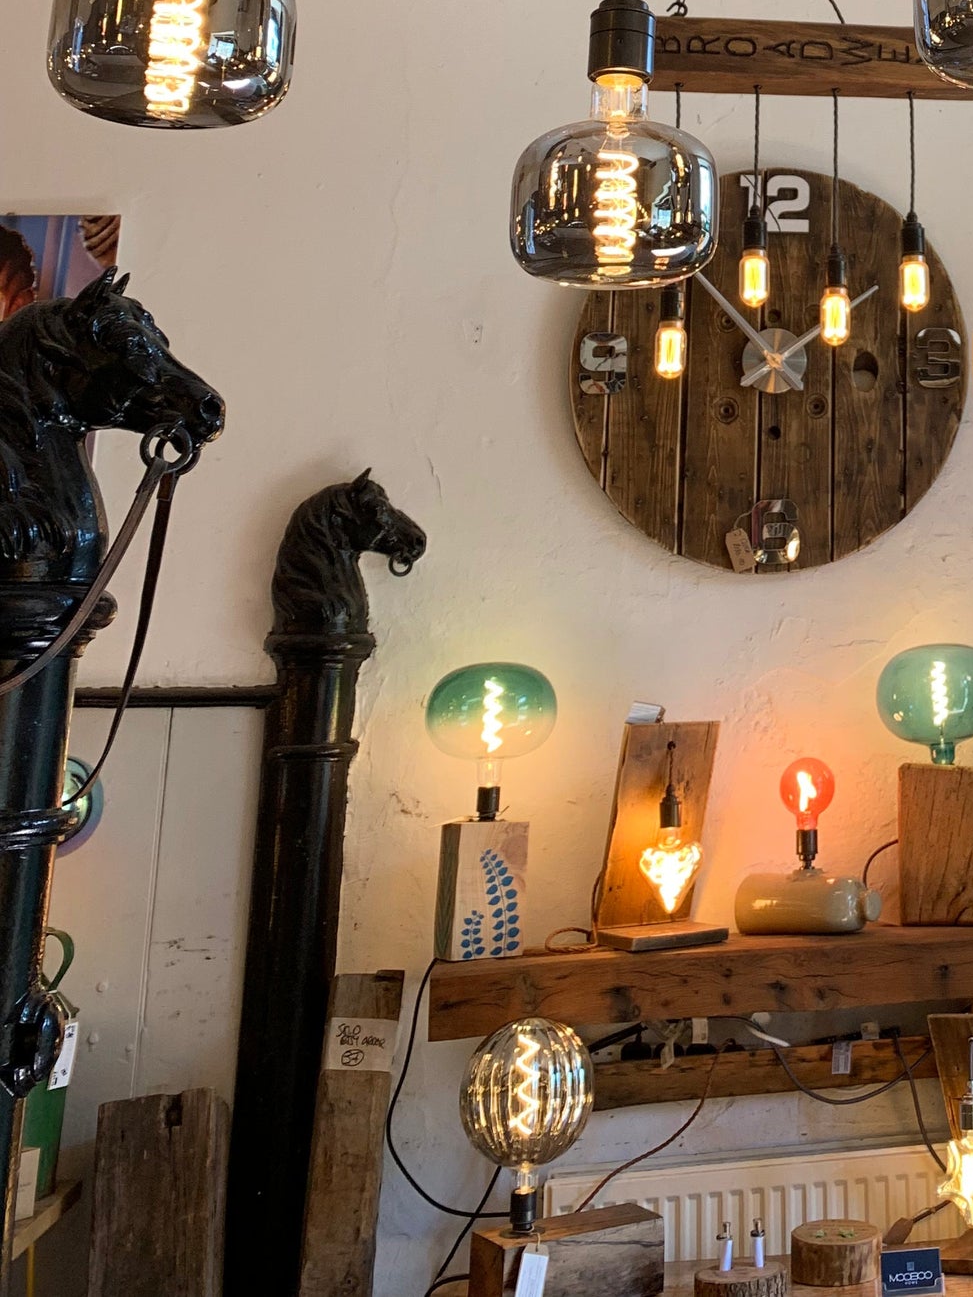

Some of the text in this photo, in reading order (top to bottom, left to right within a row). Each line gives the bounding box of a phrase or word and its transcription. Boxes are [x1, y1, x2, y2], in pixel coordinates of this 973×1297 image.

[740, 174, 810, 233] 12
[579, 331, 627, 394] 9
[915, 327, 961, 389] 3
[751, 499, 800, 564] 6
[889, 1270, 933, 1282] MOOBOO
